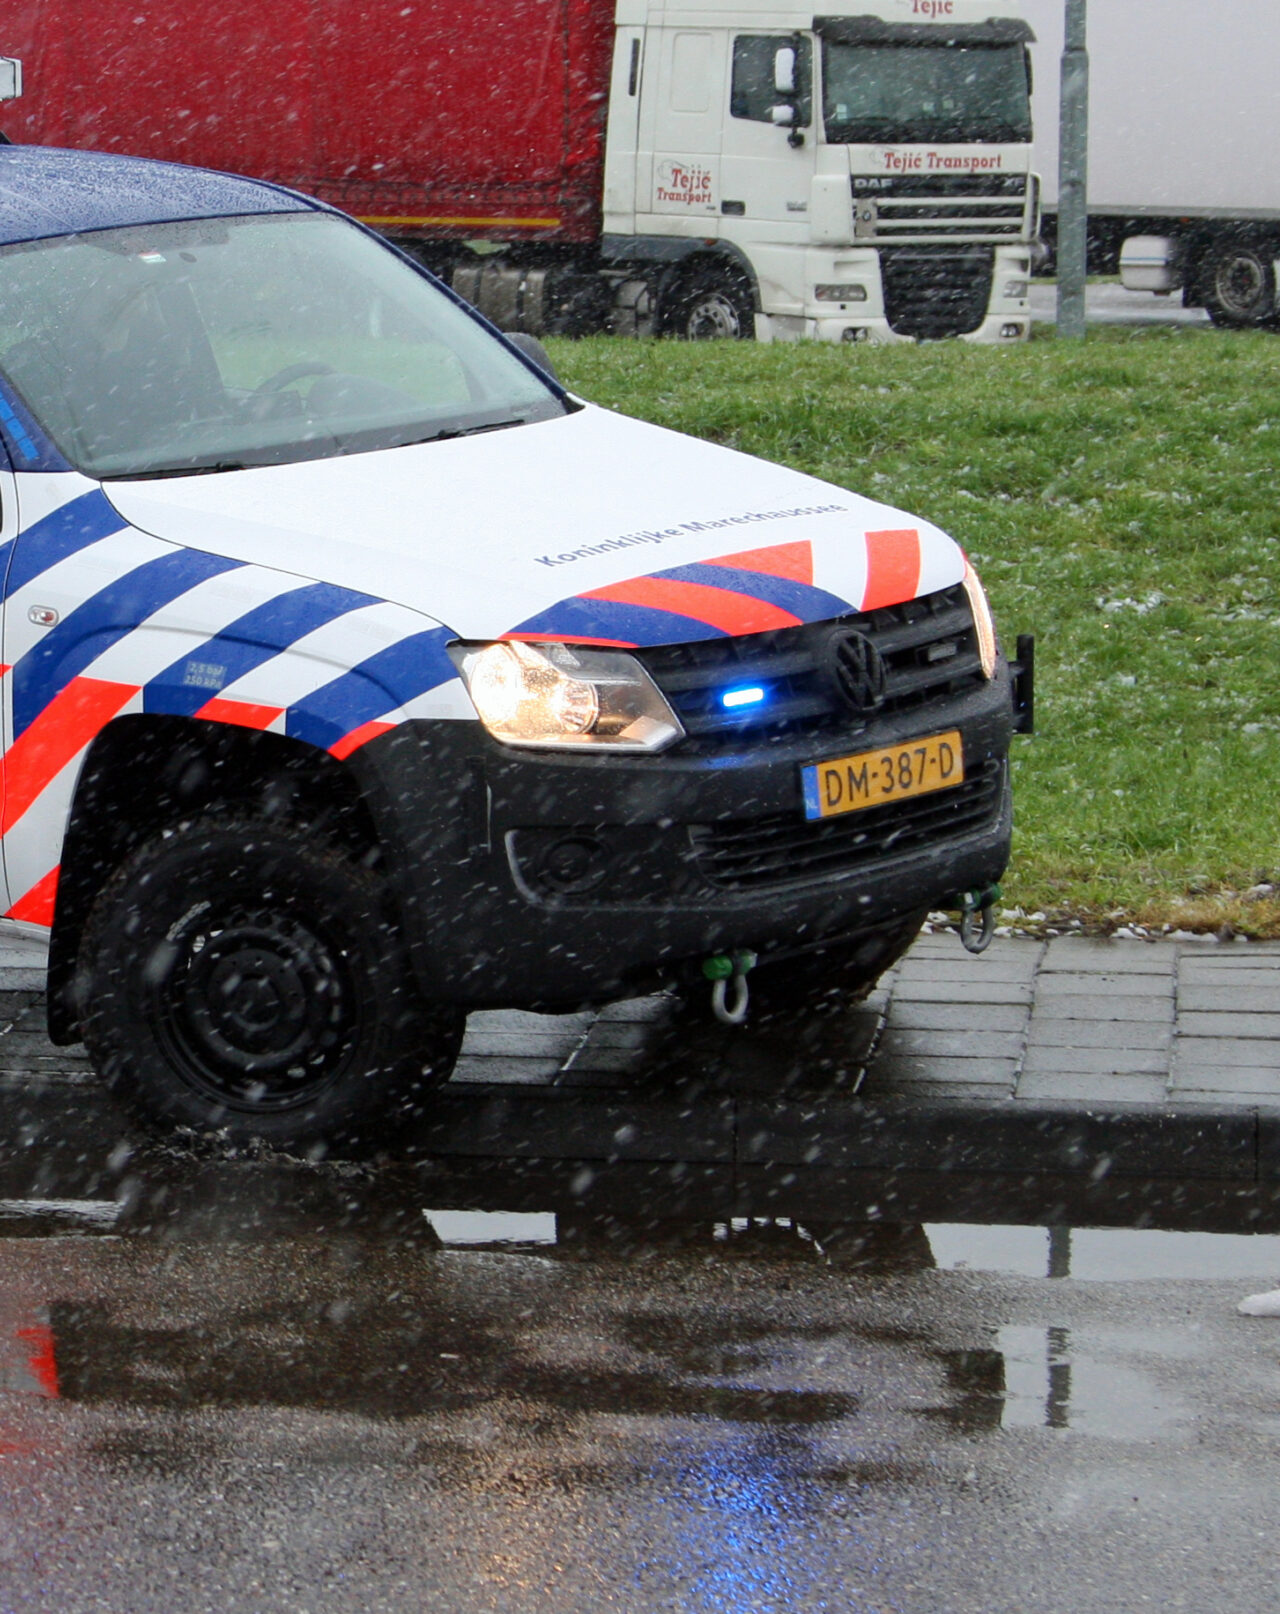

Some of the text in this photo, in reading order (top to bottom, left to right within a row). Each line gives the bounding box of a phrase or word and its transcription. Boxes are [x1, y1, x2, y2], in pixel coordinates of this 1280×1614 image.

[927, 152, 1002, 172] Transport
[854, 178, 893, 189] DAF
[657, 187, 712, 204] Transport
[533, 502, 849, 567] Koninklijke Marechaussee
[825, 742, 954, 806] DM-387-D
